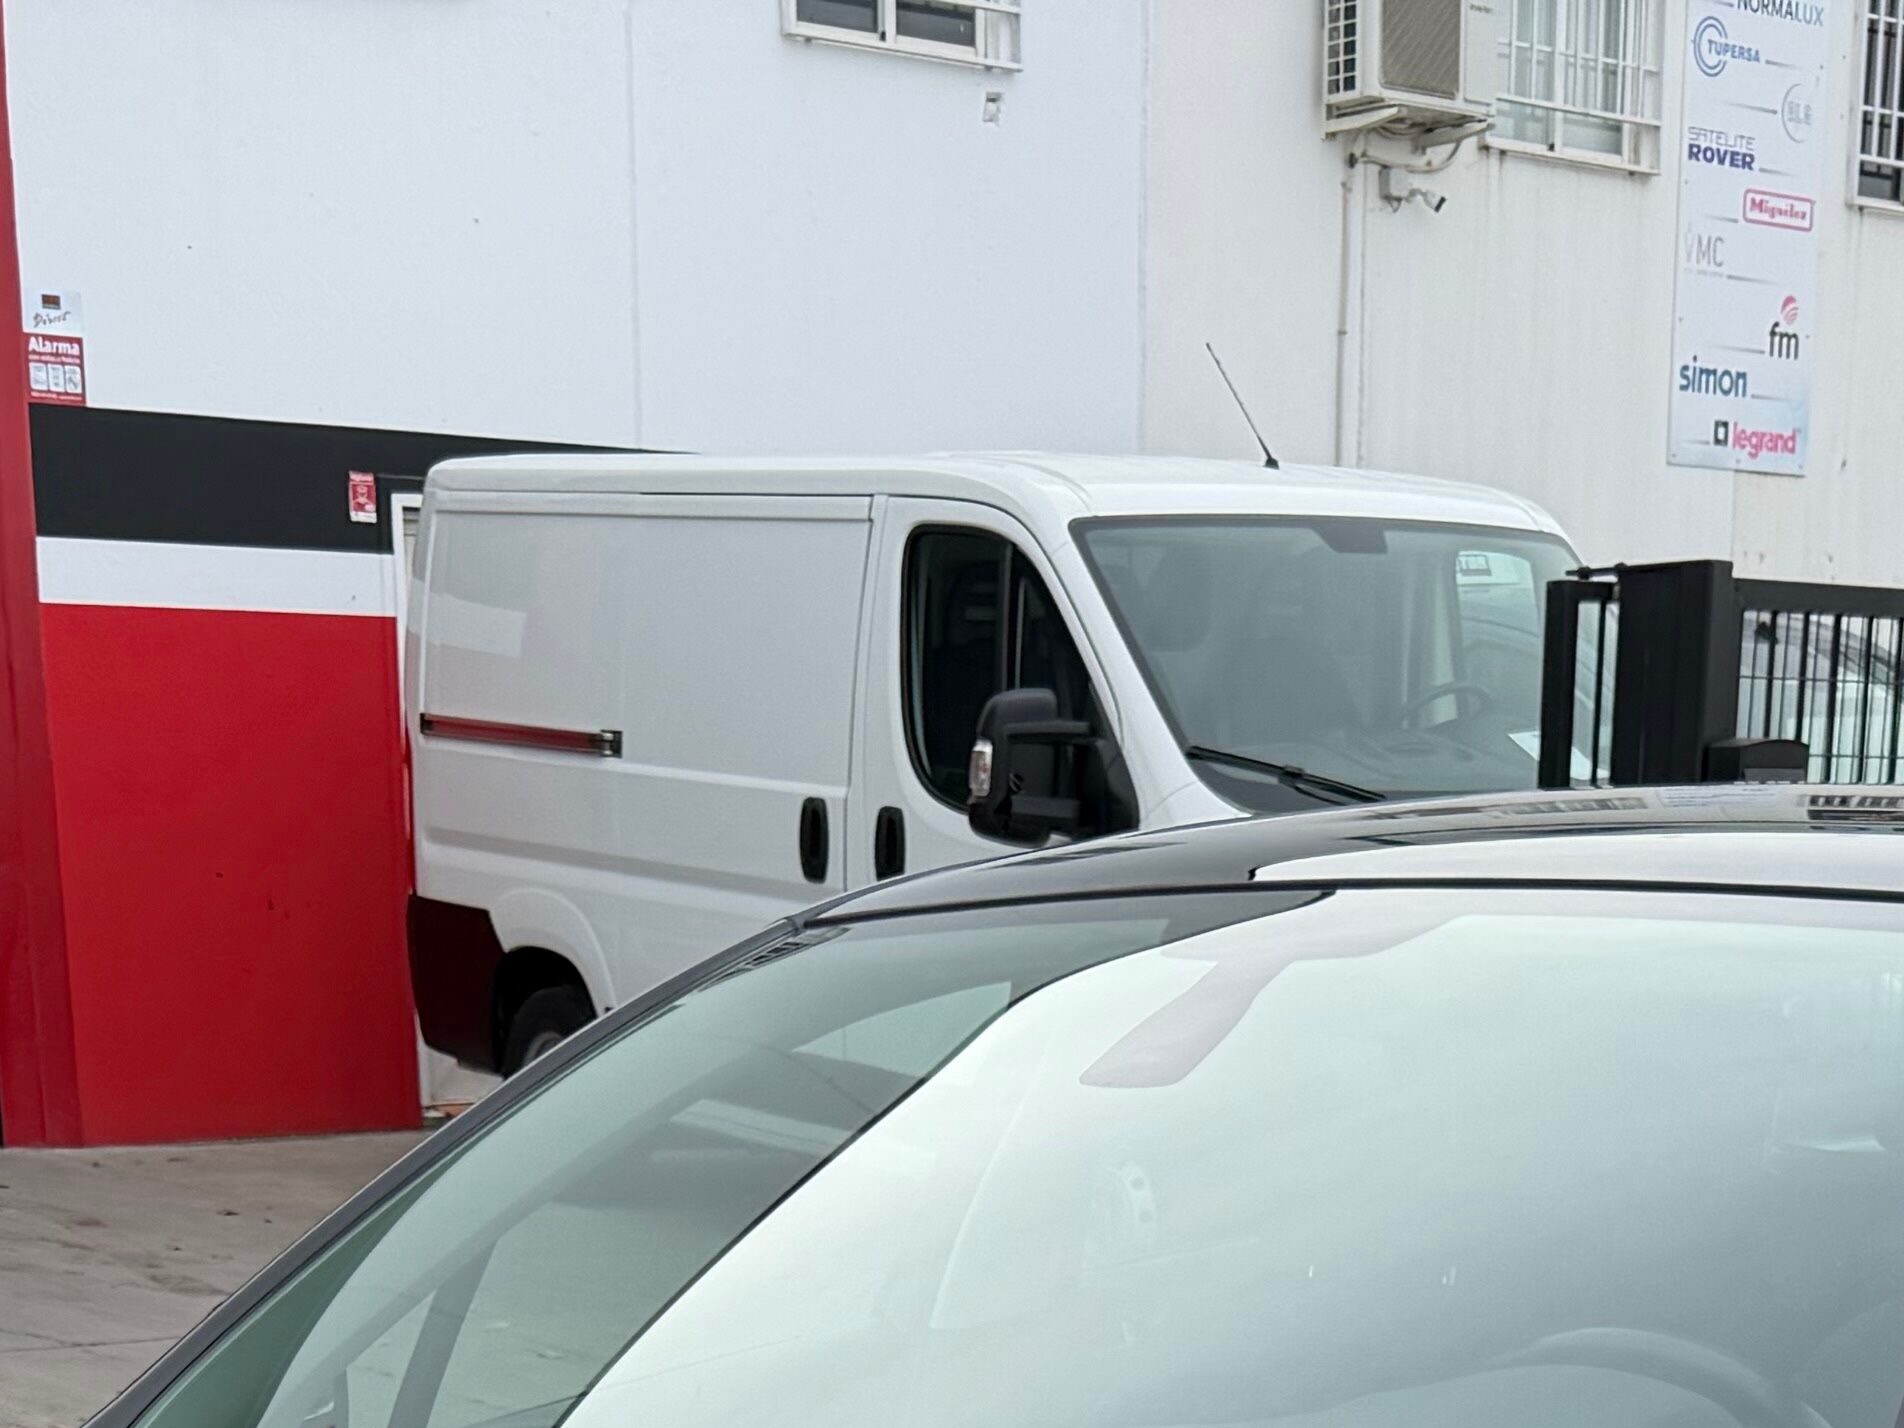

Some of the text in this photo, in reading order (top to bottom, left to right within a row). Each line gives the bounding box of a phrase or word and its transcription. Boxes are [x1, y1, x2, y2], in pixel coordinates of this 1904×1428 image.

[1737, 0, 1825, 26] NORMALUX
[1708, 39, 1760, 62] TUPERSA
[1687, 143, 1755, 171] ROVER
[28, 336, 80, 355] Alarma
[1769, 321, 1799, 360] fm
[1679, 354, 1747, 397] simon
[1732, 421, 1796, 459] legrand
